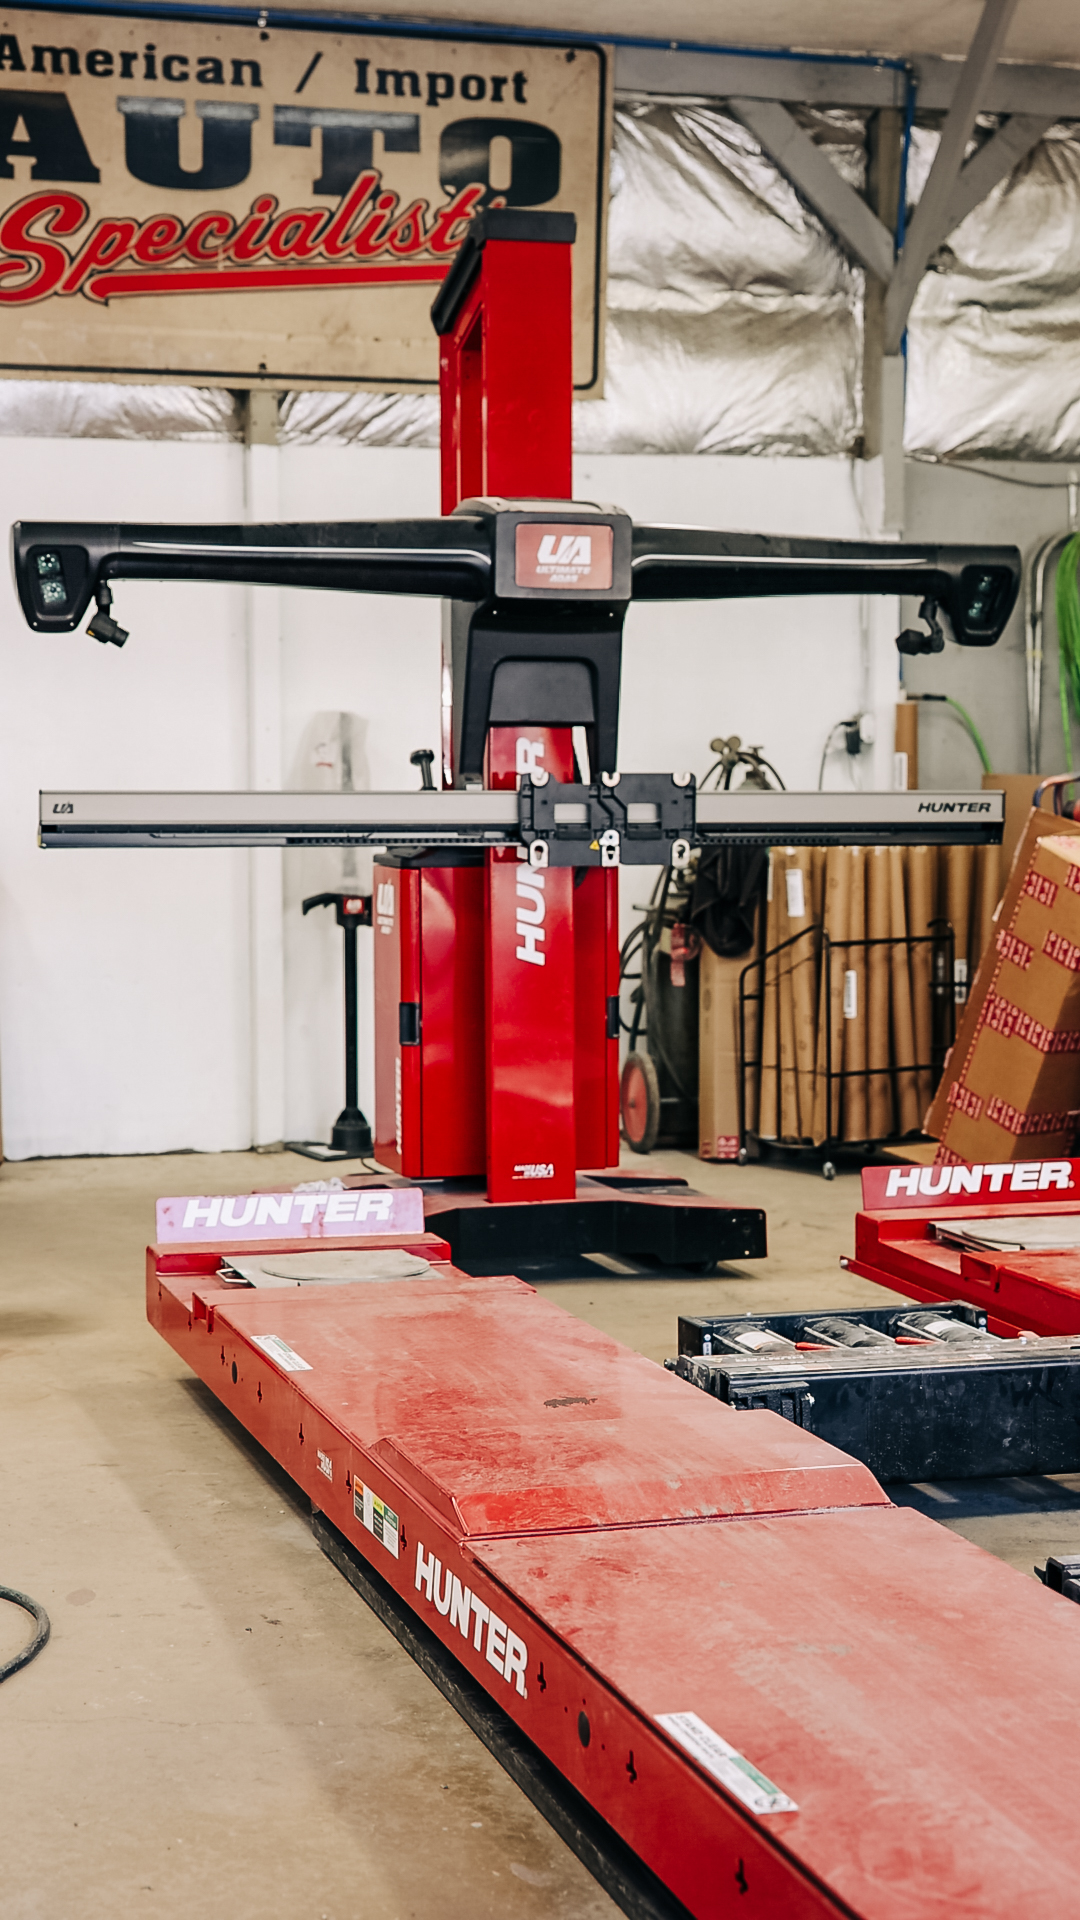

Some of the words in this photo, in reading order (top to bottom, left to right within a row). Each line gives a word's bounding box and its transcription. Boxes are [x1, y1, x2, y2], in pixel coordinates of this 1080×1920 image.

[0, 34, 263, 88] American
[354, 58, 528, 106] Import
[0, 87, 562, 207] AUTO
[0, 168, 506, 307] Specialist
[516, 737, 546, 966] HUNR
[918, 802, 991, 813] HUNTER
[182, 1193, 394, 1229] HUNTER
[886, 1161, 1075, 1197] HUNTER
[415, 1541, 528, 1699] HUNTER
